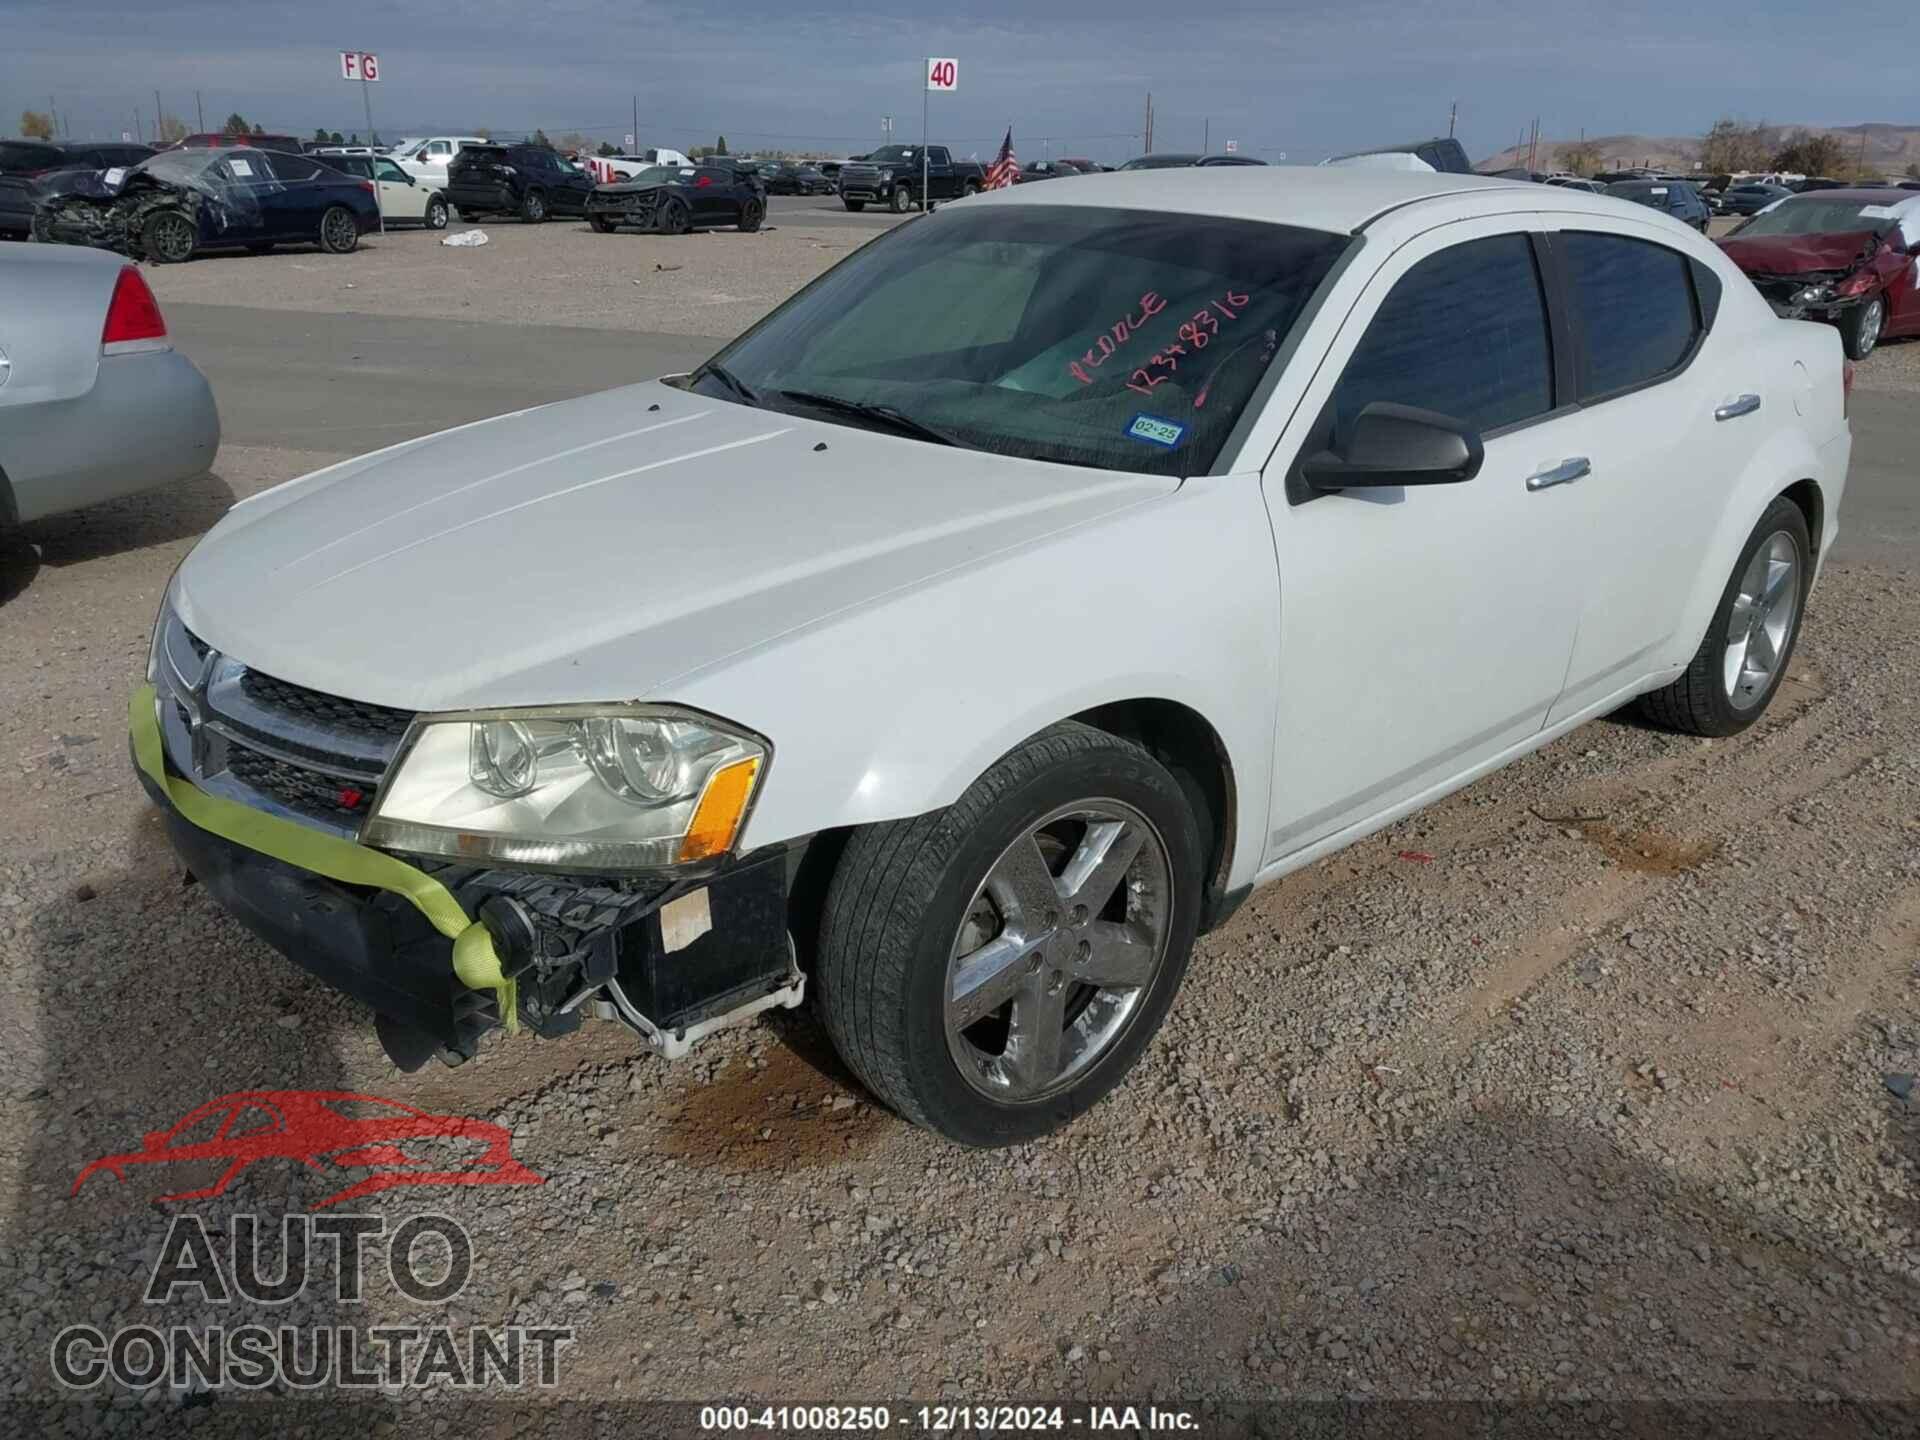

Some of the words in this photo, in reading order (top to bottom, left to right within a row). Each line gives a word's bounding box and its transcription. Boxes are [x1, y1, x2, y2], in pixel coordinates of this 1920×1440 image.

[345, 53, 355, 77] F
[363, 55, 377, 79] G
[931, 61, 955, 87] 40
